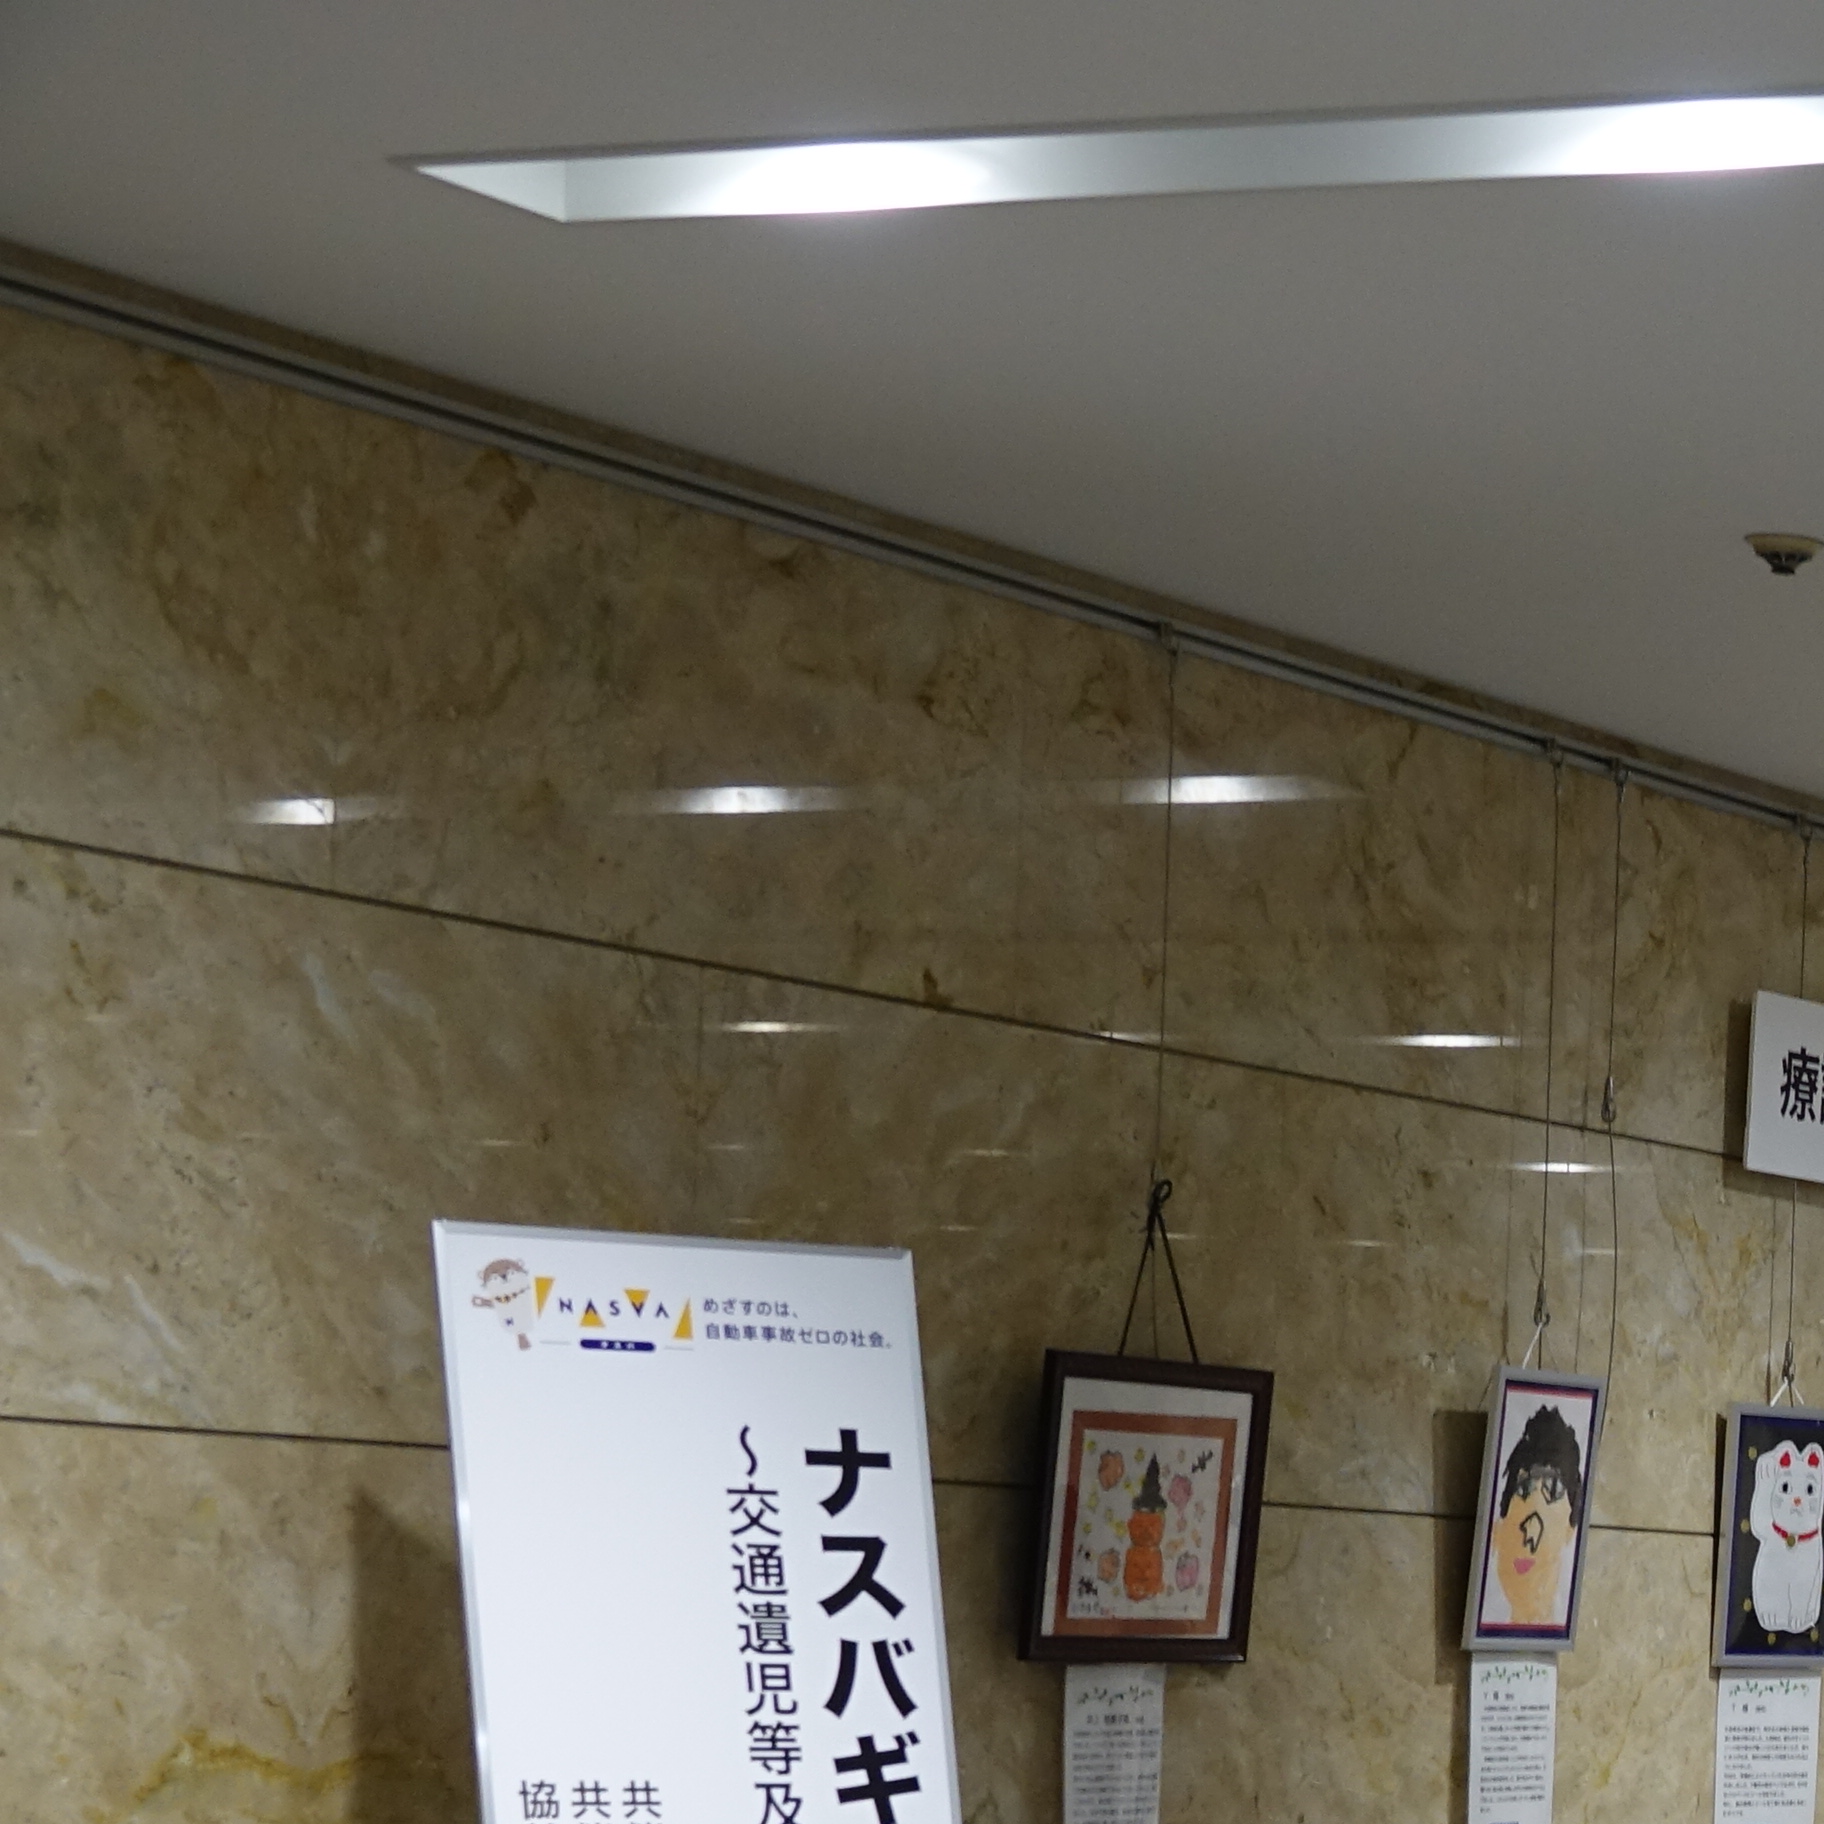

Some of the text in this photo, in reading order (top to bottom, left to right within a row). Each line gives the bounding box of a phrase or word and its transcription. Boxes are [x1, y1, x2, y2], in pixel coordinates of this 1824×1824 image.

[703, 1296, 798, 1320] めざすのは、
[706, 1322, 893, 1349] 自動車事故ゼロの社会。
